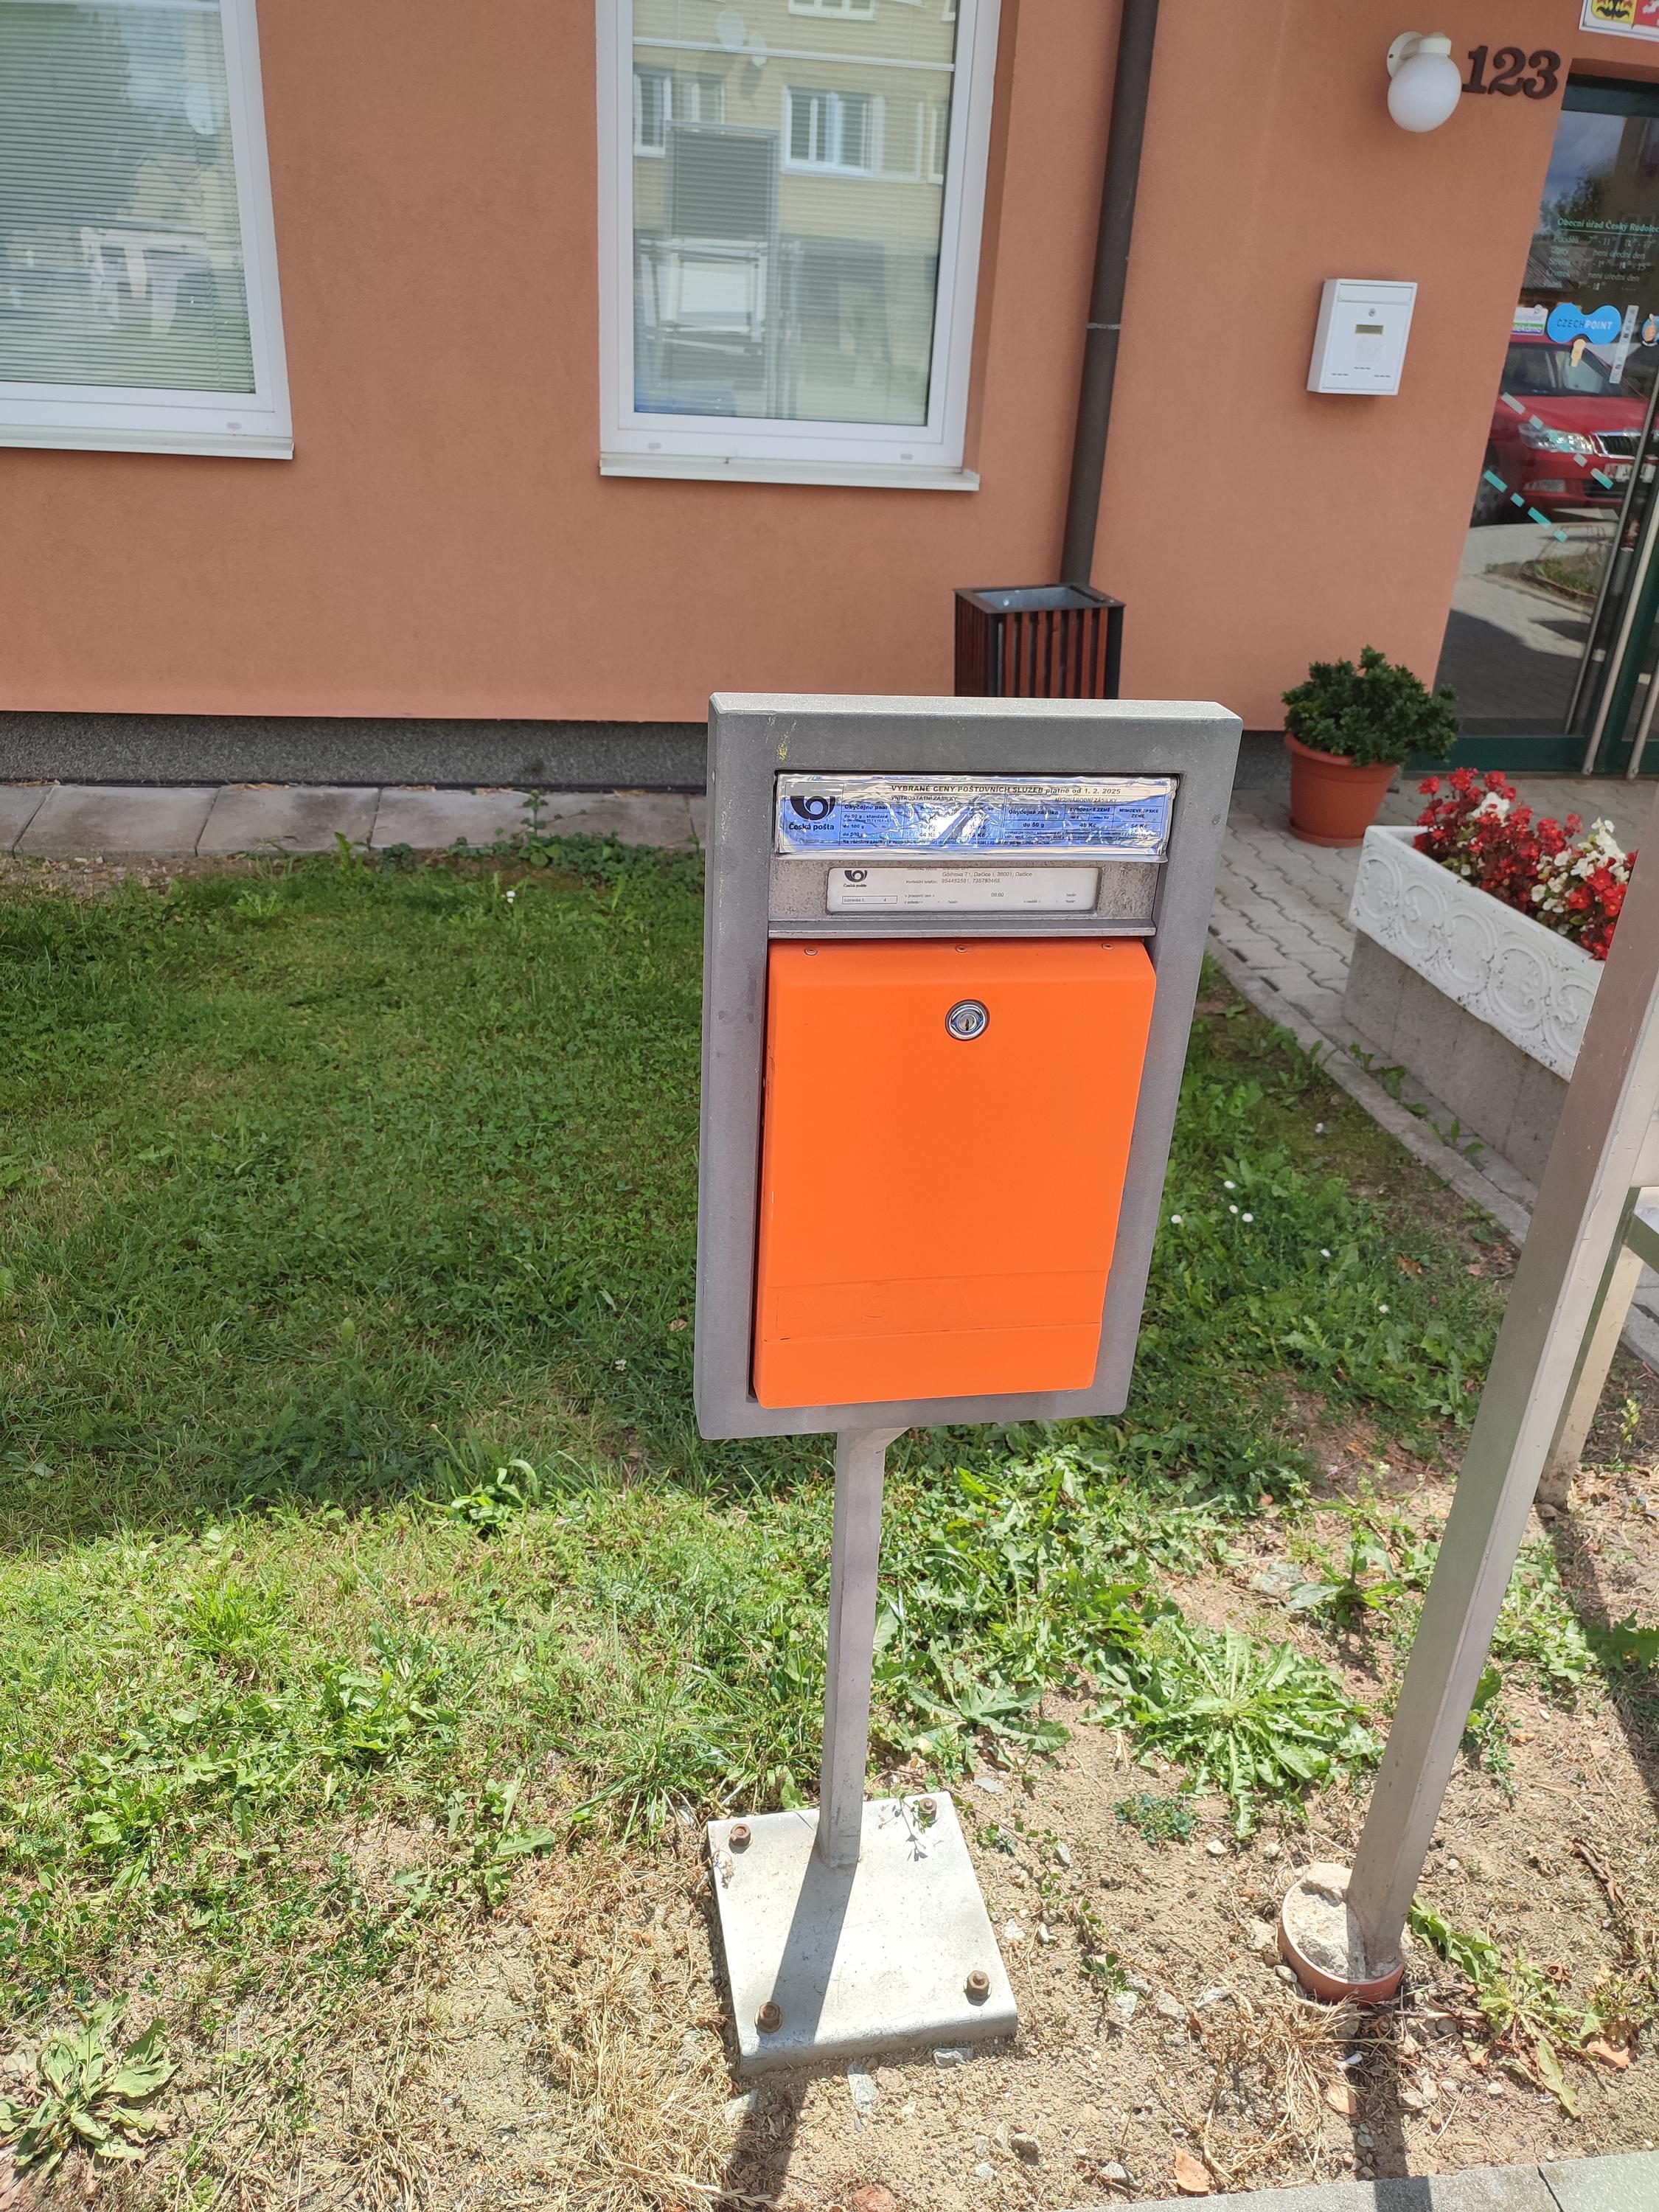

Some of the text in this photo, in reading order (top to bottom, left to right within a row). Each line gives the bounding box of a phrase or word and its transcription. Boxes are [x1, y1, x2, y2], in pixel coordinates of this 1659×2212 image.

[1462, 46, 1561, 100] 123
[789, 822, 835, 831] Česká pošta
